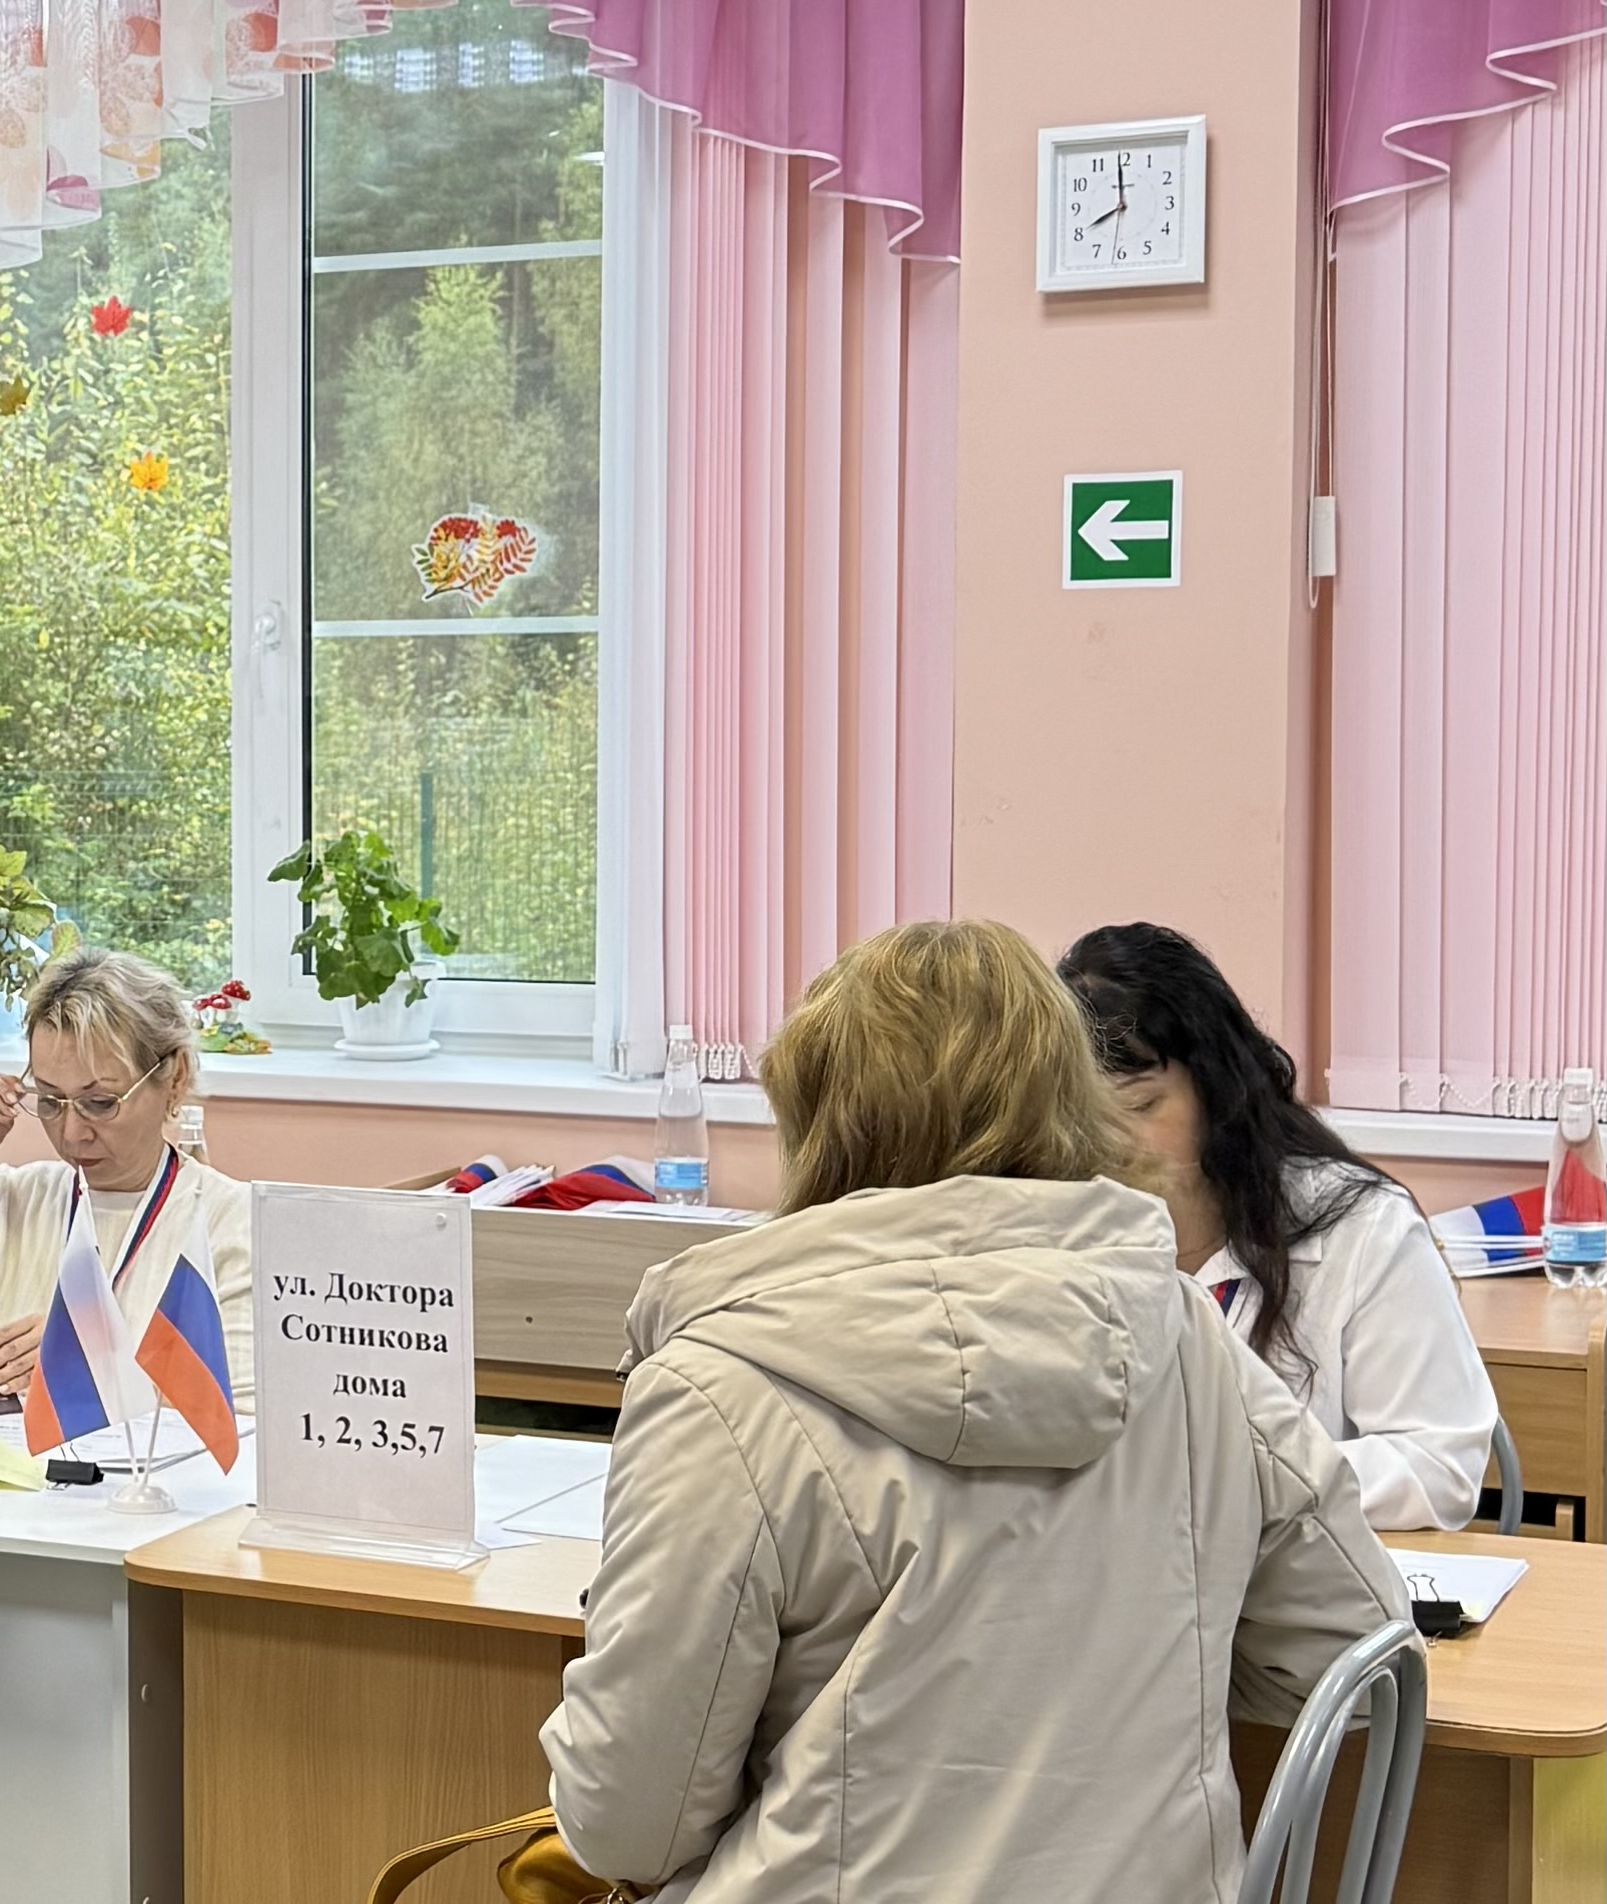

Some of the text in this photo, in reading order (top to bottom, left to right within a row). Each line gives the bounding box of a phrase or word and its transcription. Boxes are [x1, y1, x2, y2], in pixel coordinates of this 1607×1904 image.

[1092, 158, 1105, 172] 11
[1147, 154, 1152, 168] 1
[1073, 177, 1088, 192] 10
[1162, 171, 1172, 185] 2
[1071, 202, 1081, 216] 9
[1165, 195, 1175, 210] 3
[1073, 227, 1084, 242] 8
[1161, 221, 1170, 235] 4
[1092, 244, 1101, 258] 7
[1117, 246, 1127, 259] 6
[1142, 240, 1152, 255] 5
[273, 1272, 454, 1313] ул. Доктора
[281, 1313, 449, 1353] Сотникова
[332, 1373, 407, 1399] дома
[300, 1412, 445, 1459] 1, 2, 3,5,7
